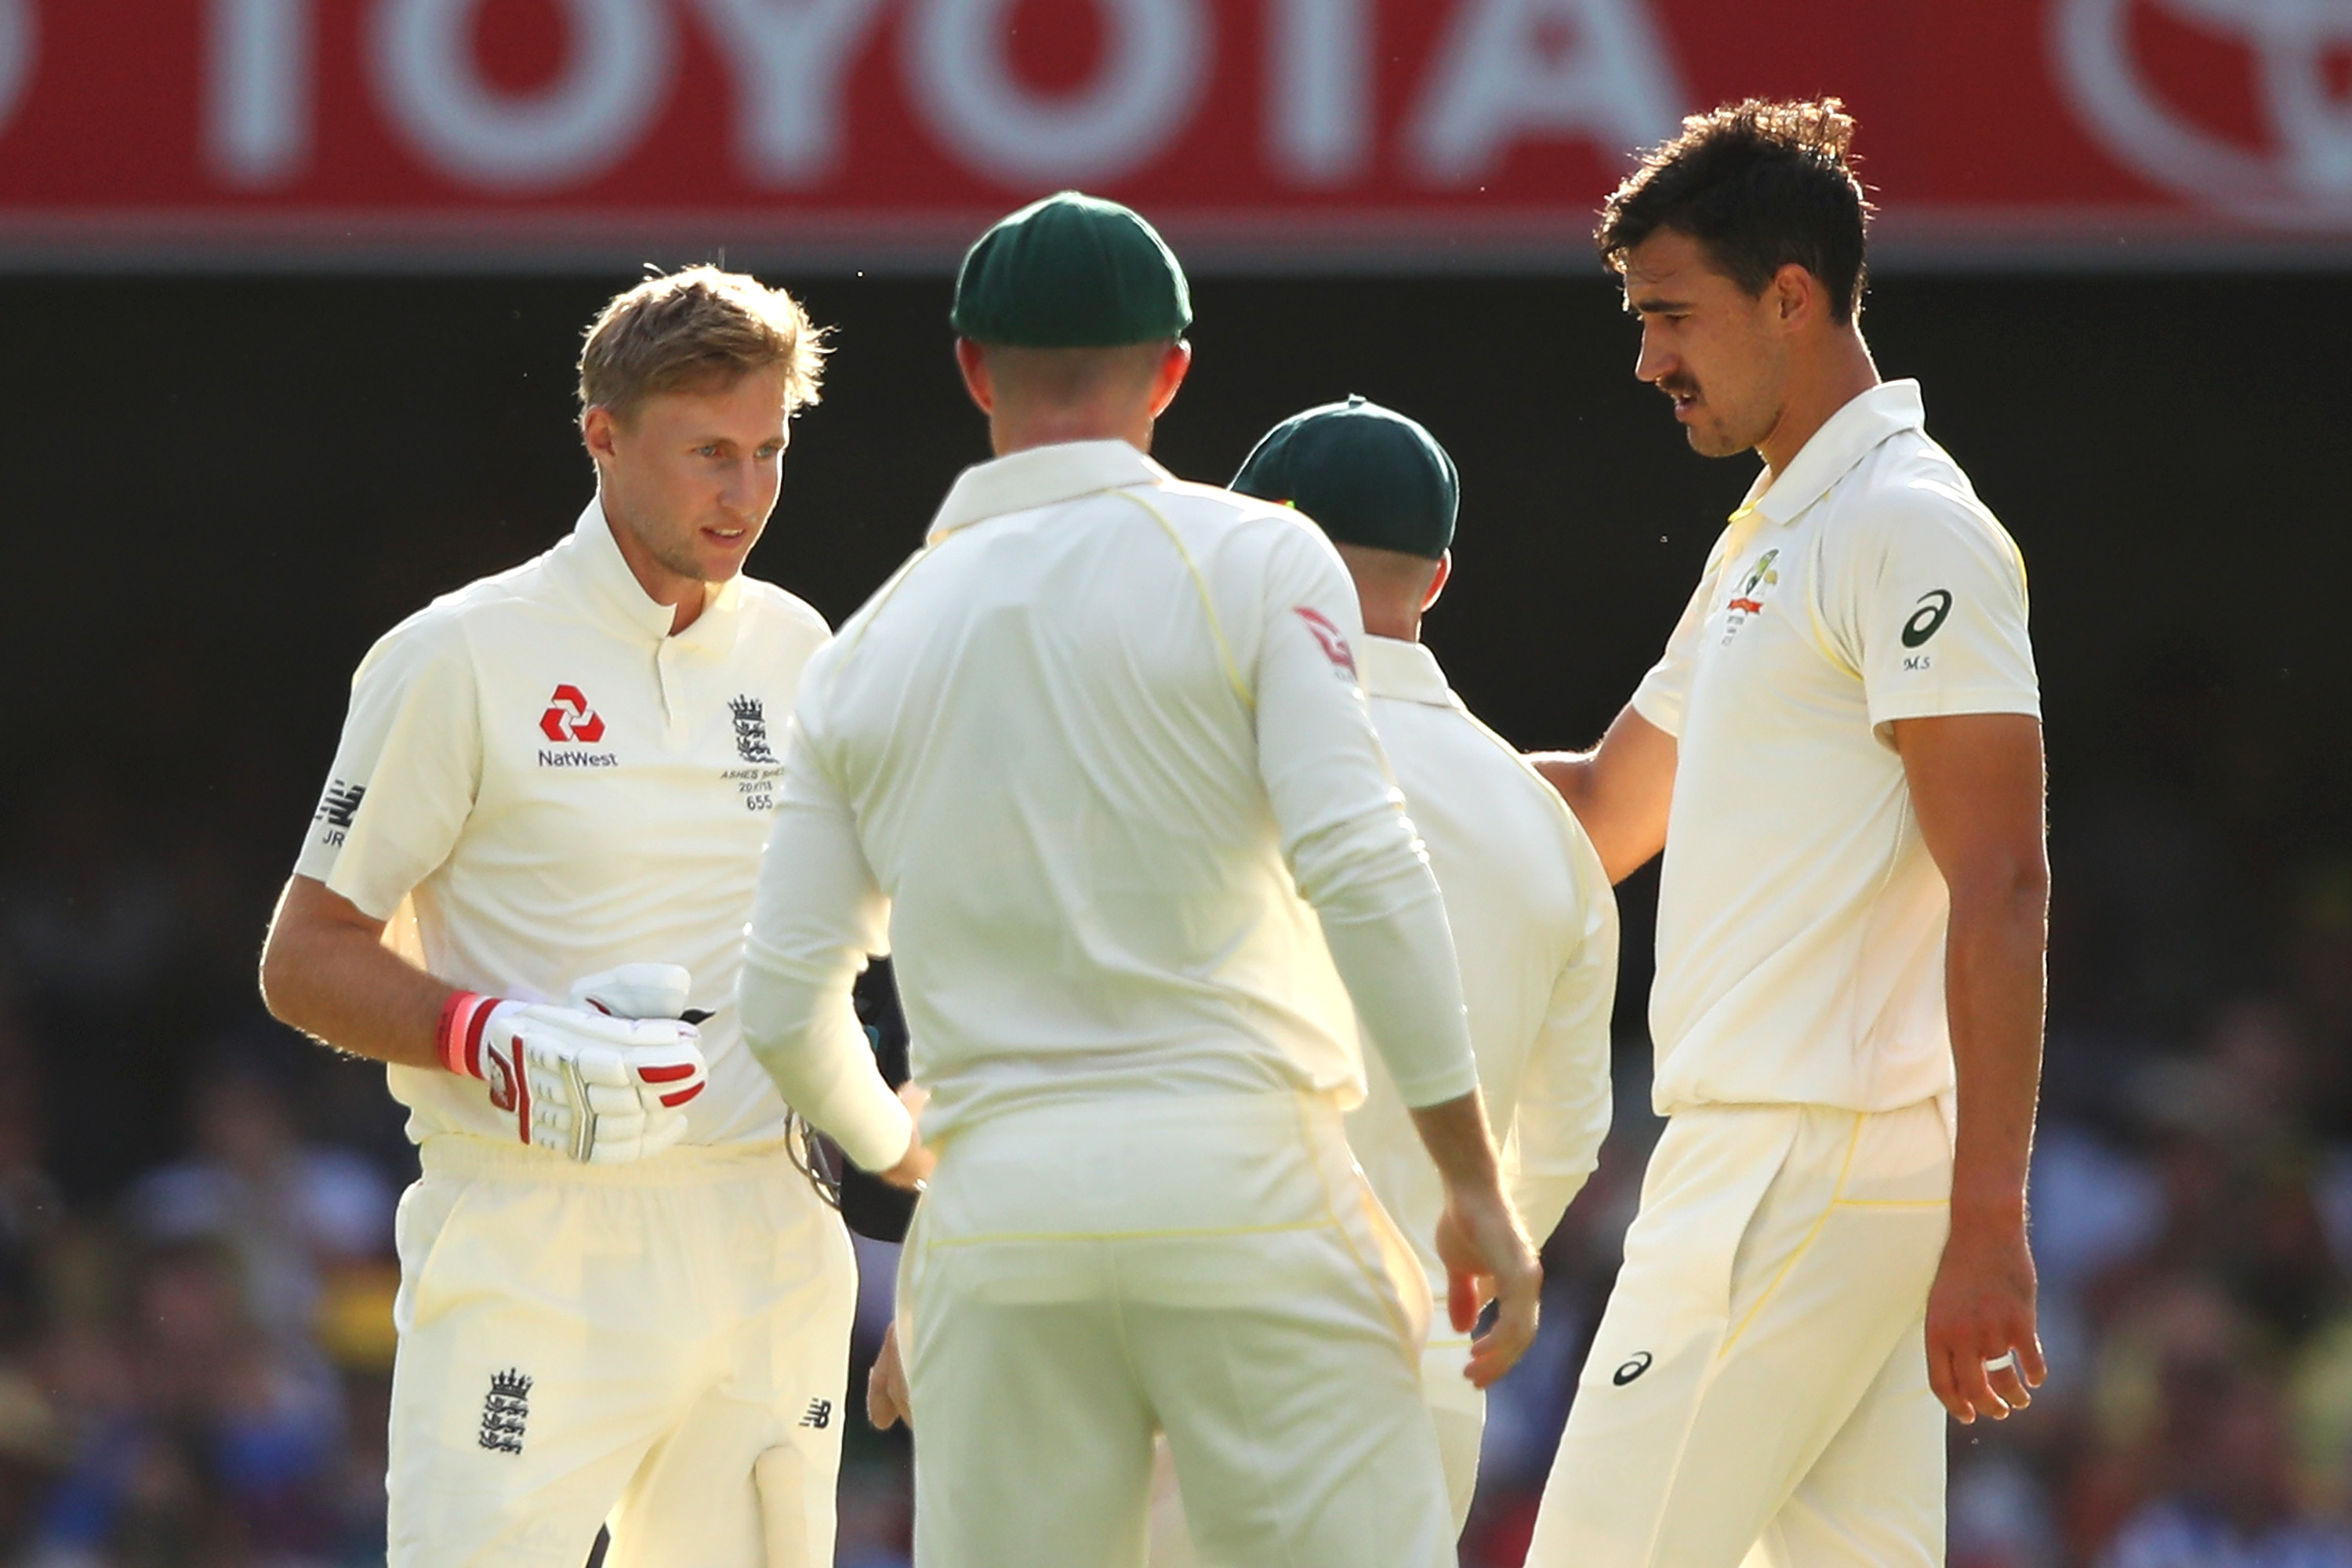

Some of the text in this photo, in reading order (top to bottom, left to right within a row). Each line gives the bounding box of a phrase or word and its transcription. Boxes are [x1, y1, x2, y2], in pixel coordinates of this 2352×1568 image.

[539, 750, 617, 766] NatWest
[746, 795, 773, 811] 655
[322, 830, 345, 848] JR
